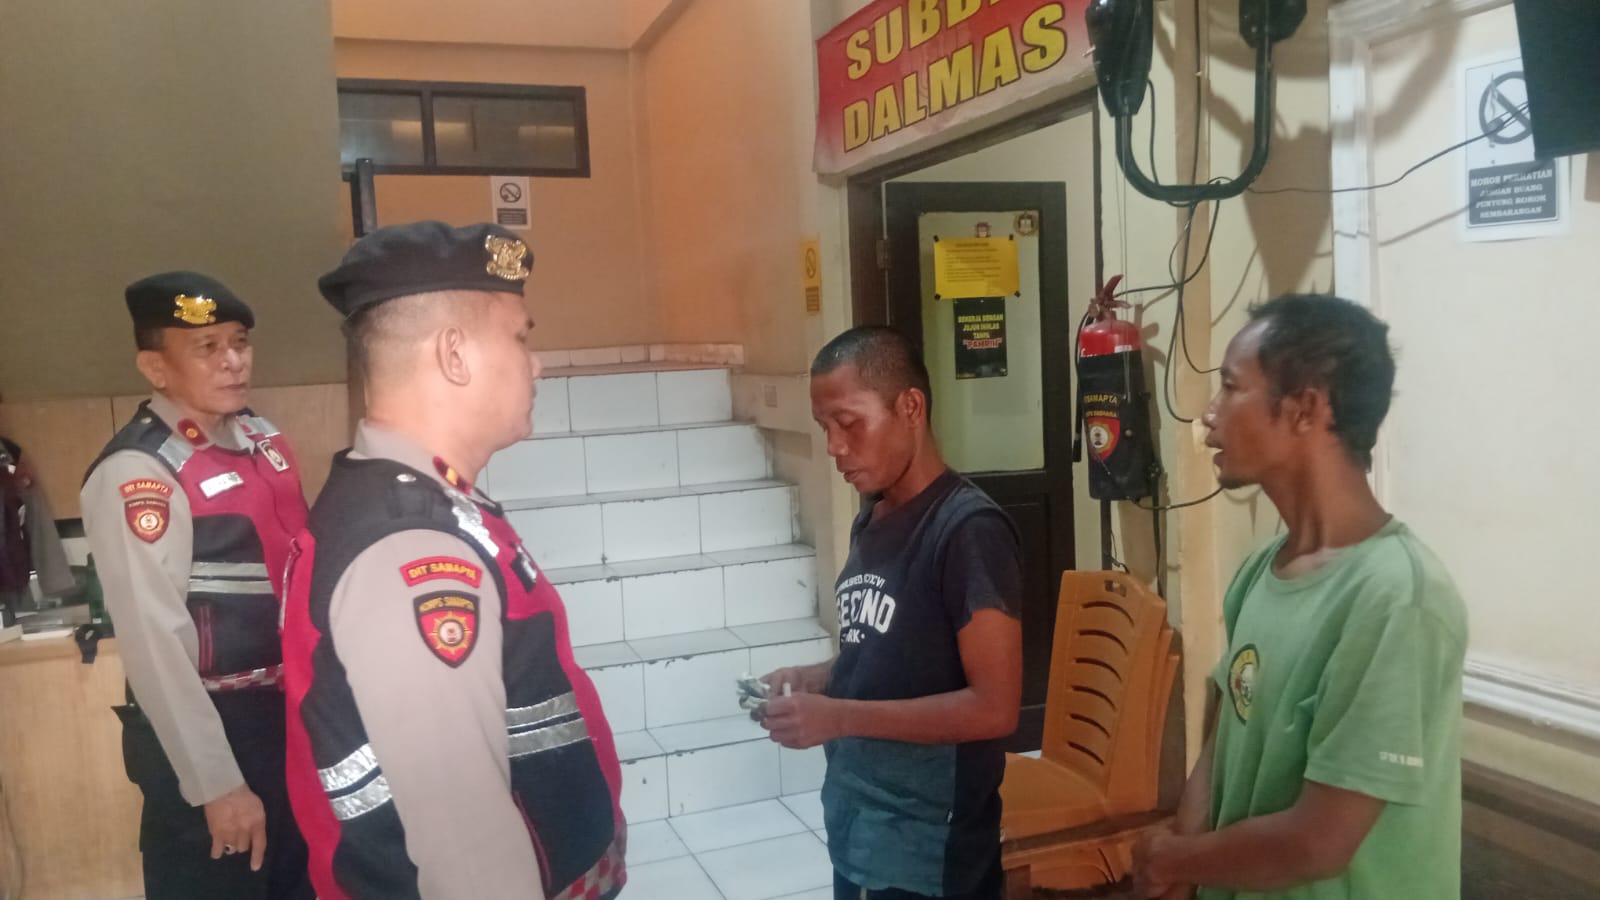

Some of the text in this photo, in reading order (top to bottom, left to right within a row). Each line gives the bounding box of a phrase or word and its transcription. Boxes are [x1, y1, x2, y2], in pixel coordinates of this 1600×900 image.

[847, 0, 1001, 80] SUBD
[843, 3, 1067, 153] DALMAS
[1503, 169, 1553, 182] PATIAN
[1480, 187, 1512, 197] JGAN
[136, 481, 169, 493] SAMAPTA
[408, 565, 428, 579] DIT
[837, 588, 896, 634] ECND
